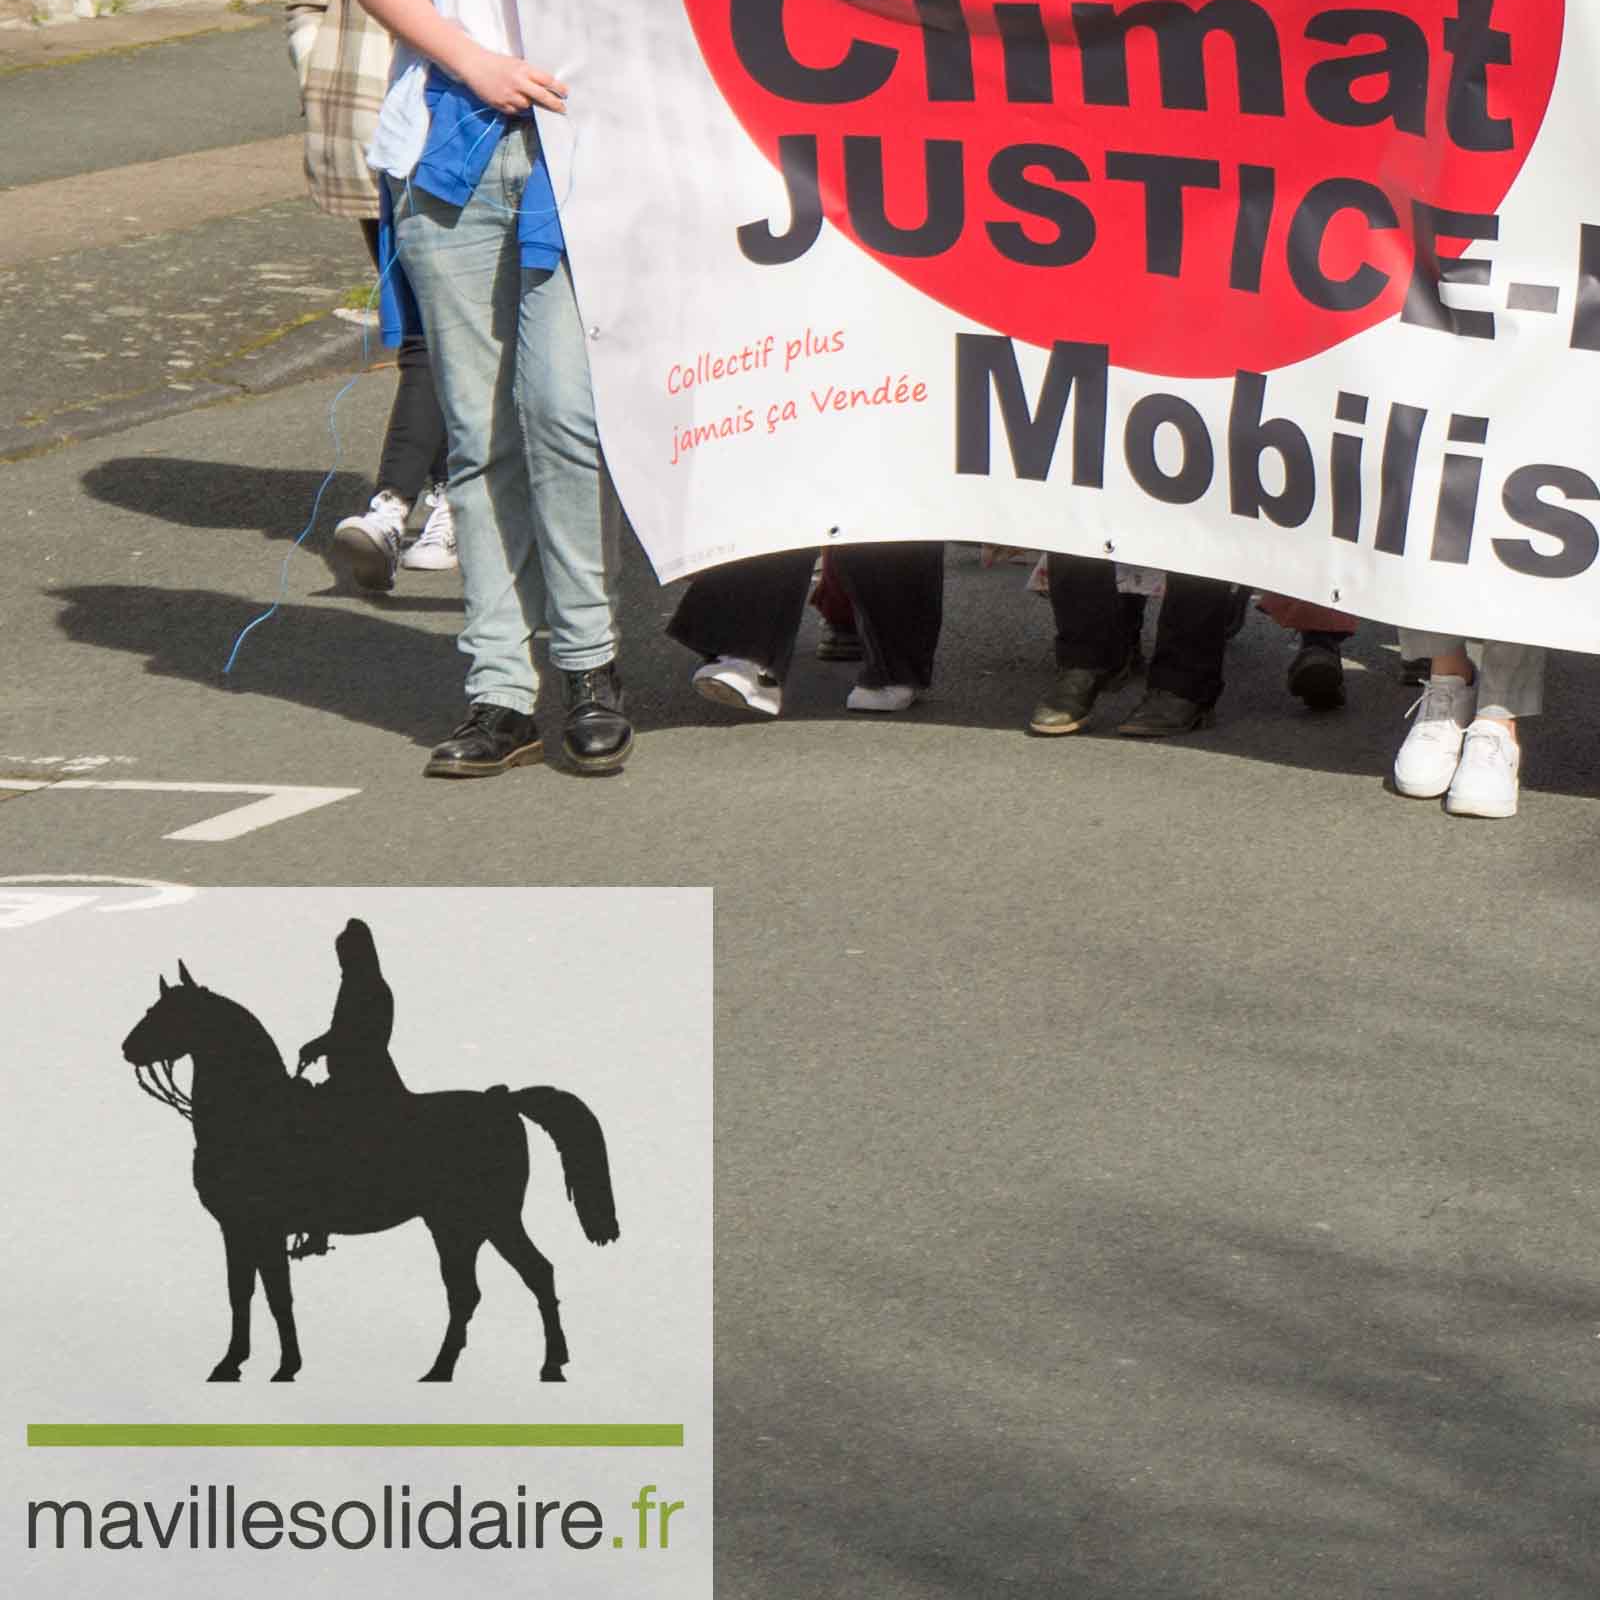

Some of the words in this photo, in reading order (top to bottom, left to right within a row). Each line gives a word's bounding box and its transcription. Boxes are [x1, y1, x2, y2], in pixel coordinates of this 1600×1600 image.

[667, 335, 775, 396] Collectif
[785, 327, 846, 373] plus
[670, 404, 754, 465] jamais
[766, 399, 799, 435] ça
[810, 374, 929, 414] Vendée
